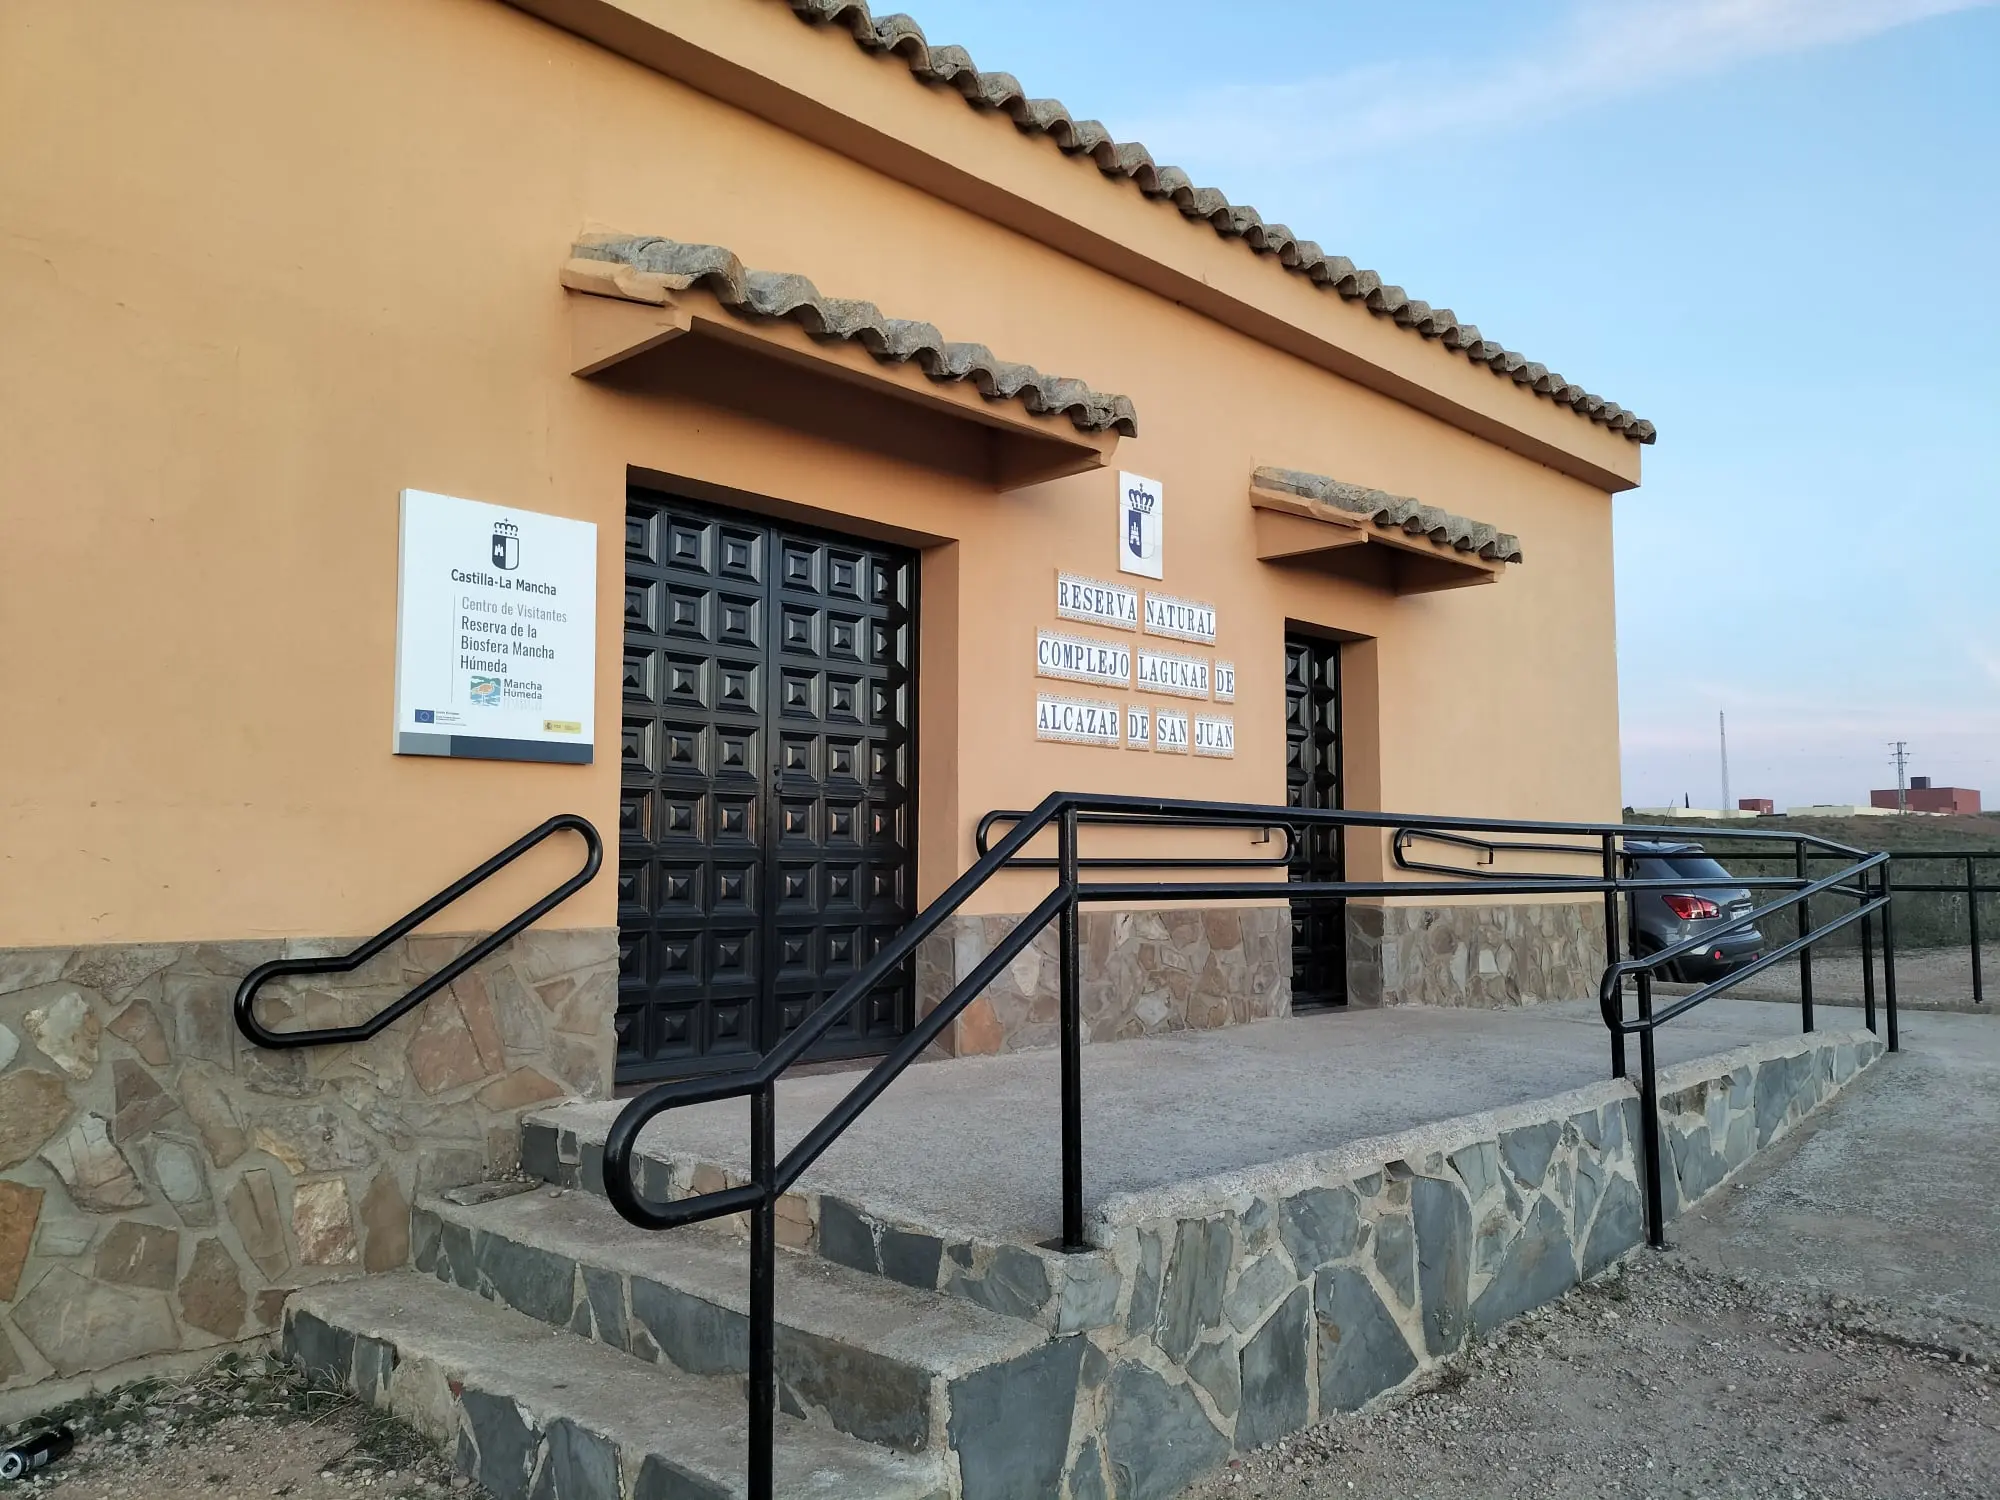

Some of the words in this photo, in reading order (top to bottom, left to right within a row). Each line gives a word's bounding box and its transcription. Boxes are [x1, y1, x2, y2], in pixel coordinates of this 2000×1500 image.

[451, 569, 512, 589] Castilla-La
[516, 578, 557, 596] Mancha
[462, 596, 498, 614] Centro
[501, 602, 513, 615] de
[517, 603, 567, 623] Visitantes
[1059, 581, 1137, 621] RESERVA
[1146, 600, 1216, 636] NATURAL
[461, 616, 507, 635] Reserva
[510, 622, 524, 637] de
[527, 624, 537, 638] la
[461, 635, 508, 654] Biosfera
[512, 641, 555, 659] Mancha
[460, 655, 507, 673] Húmeda
[1038, 639, 1129, 678] COMPLEJO
[1138, 656, 1208, 690] LAGUNAR
[1216, 668, 1234, 693] DE
[503, 678, 543, 690] Mancha
[1038, 704, 1119, 737] ALCAZAR
[1129, 714, 1149, 738] DE
[1158, 717, 1187, 743] SAN
[1196, 722, 1233, 749] JUAN
